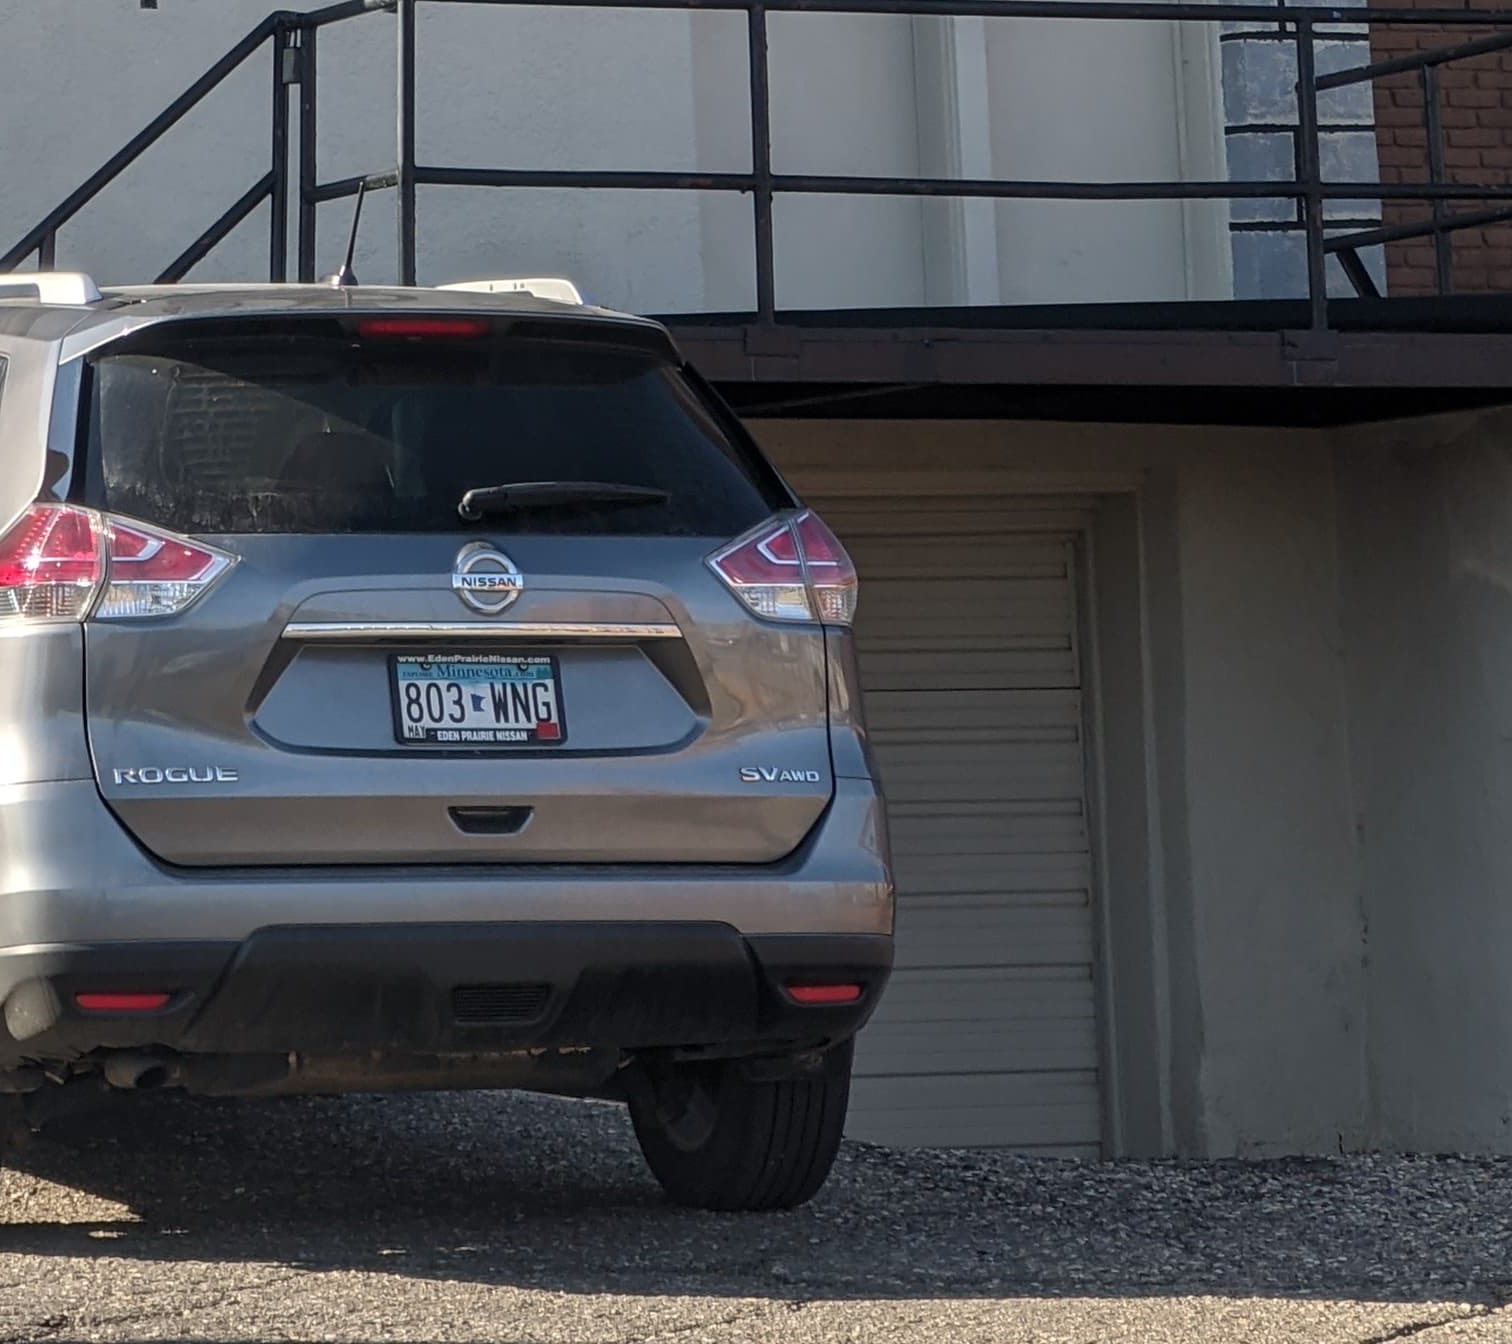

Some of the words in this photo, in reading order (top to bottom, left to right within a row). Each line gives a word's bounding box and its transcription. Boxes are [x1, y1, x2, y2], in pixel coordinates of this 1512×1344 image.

[462, 576, 517, 587] NISSAN
[397, 654, 551, 664] www.EdenPrairieNissan.com
[437, 664, 512, 679] Minnesota
[405, 682, 466, 724] 803
[490, 682, 552, 723] WNG
[437, 730, 459, 741] EDEN
[461, 730, 494, 742] PRAIRIE
[495, 730, 528, 742] NISSAN
[112, 766, 239, 784] ROGUE
